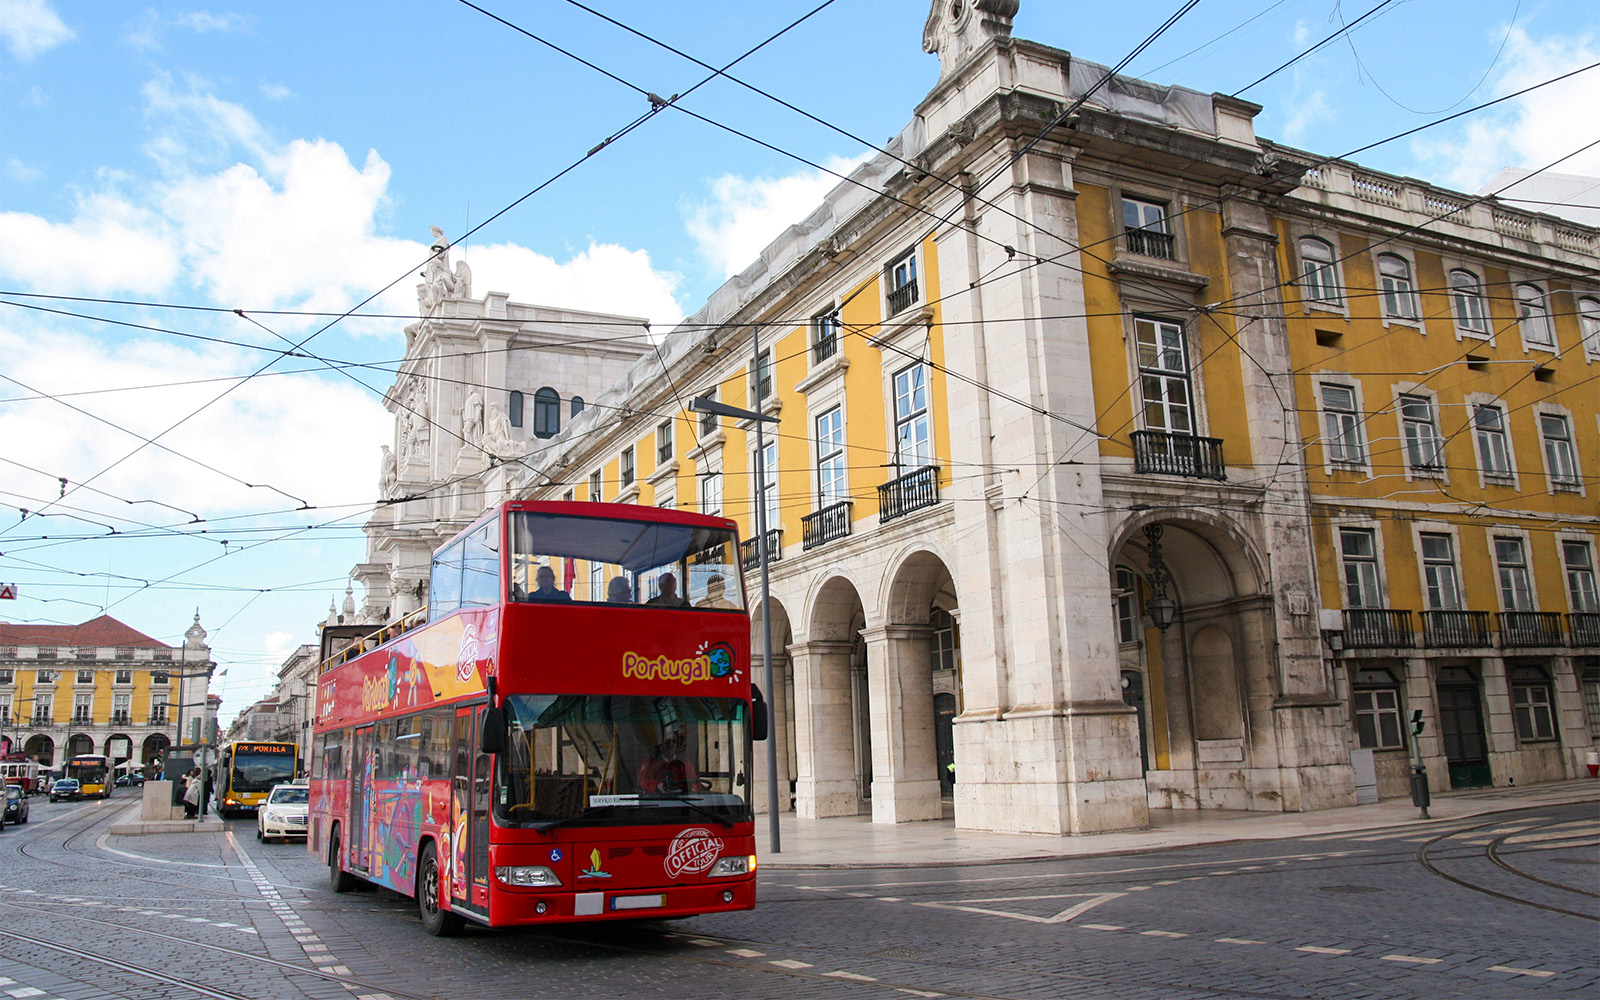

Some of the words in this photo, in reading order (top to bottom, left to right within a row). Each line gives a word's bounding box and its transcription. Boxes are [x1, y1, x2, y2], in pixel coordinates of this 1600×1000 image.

[622, 651, 711, 685] Portugal
[253, 745, 287, 753] PORTELA
[671, 837, 722, 869] OFFICIAL
[693, 851, 715, 867] TOUR
